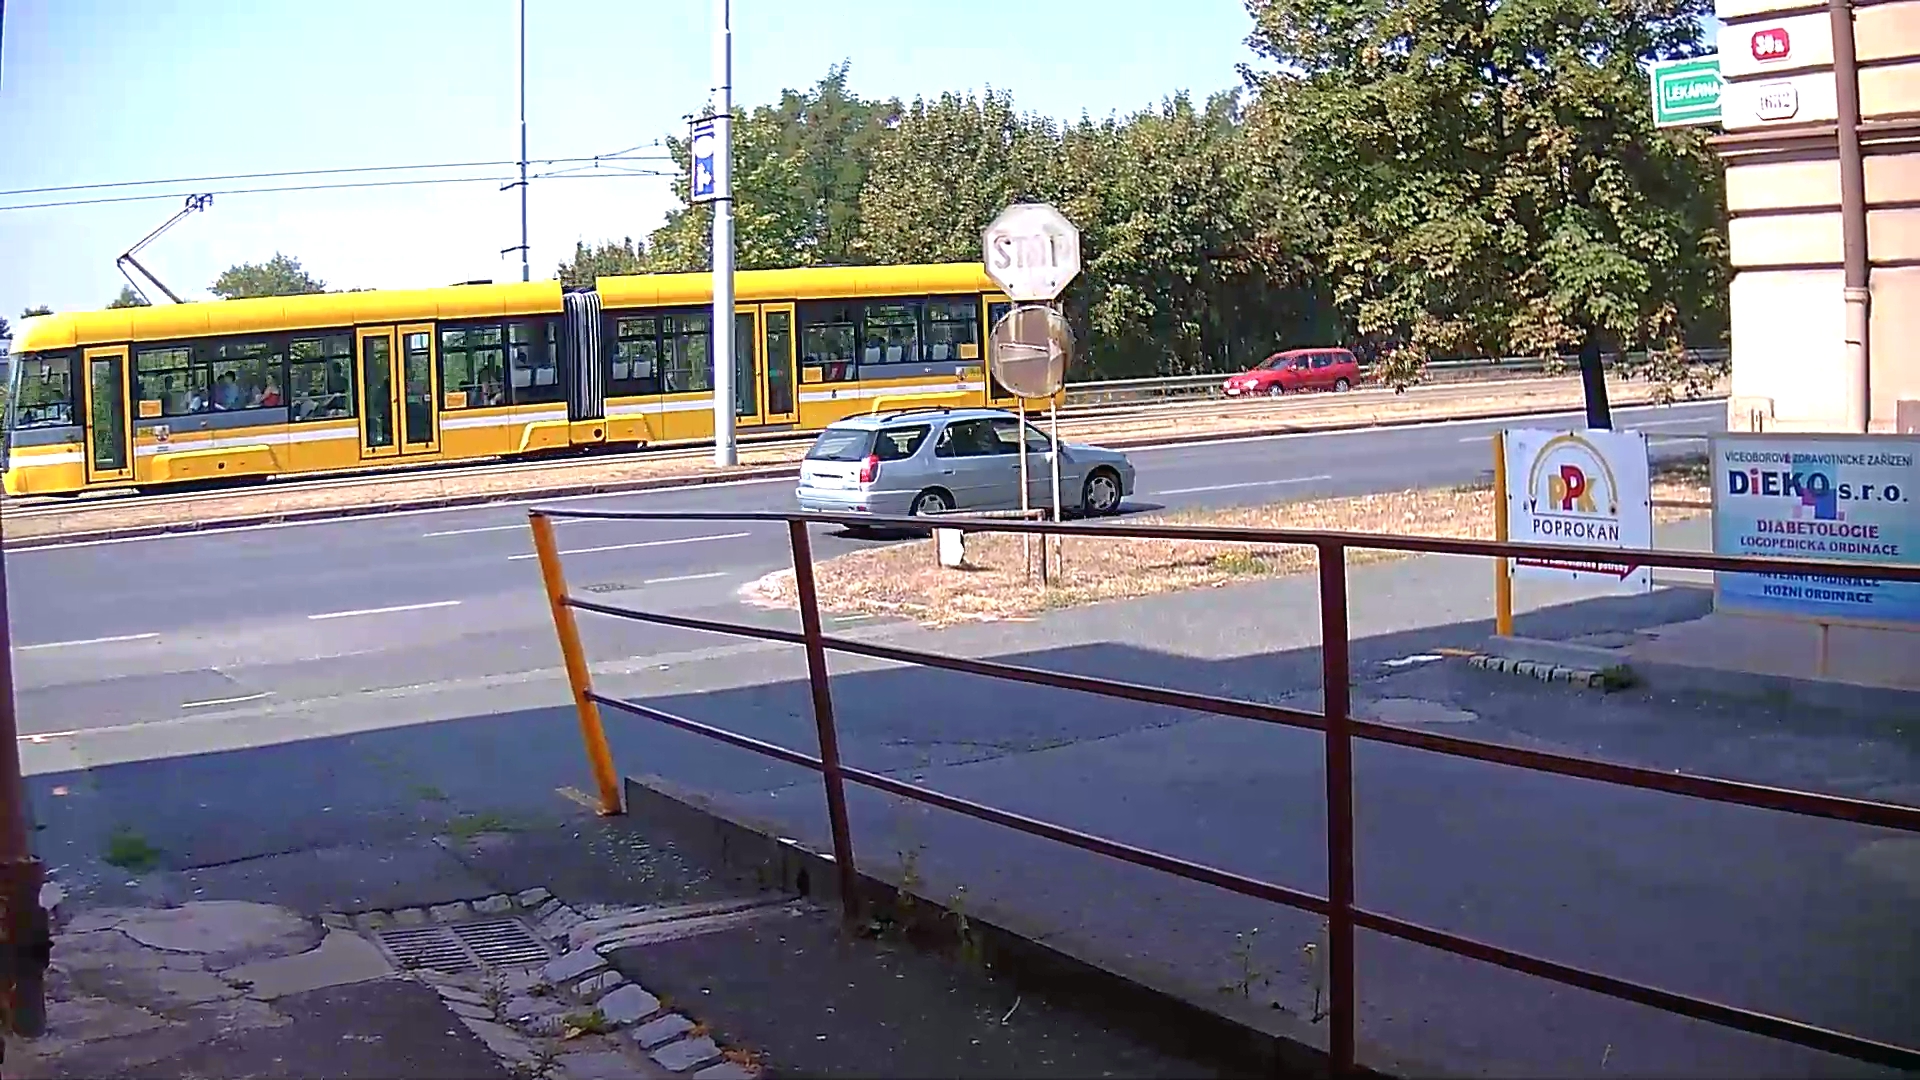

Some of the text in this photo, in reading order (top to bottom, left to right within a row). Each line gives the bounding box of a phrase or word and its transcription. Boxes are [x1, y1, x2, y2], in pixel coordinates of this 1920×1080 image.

[993, 234, 1068, 269] STOP
[1533, 518, 1619, 541] POPROKAN
[1757, 519, 1880, 539] DIABETOLOGIE
[1829, 542, 1899, 556] ORDINACE
[1805, 587, 1874, 603] ORDINACE
